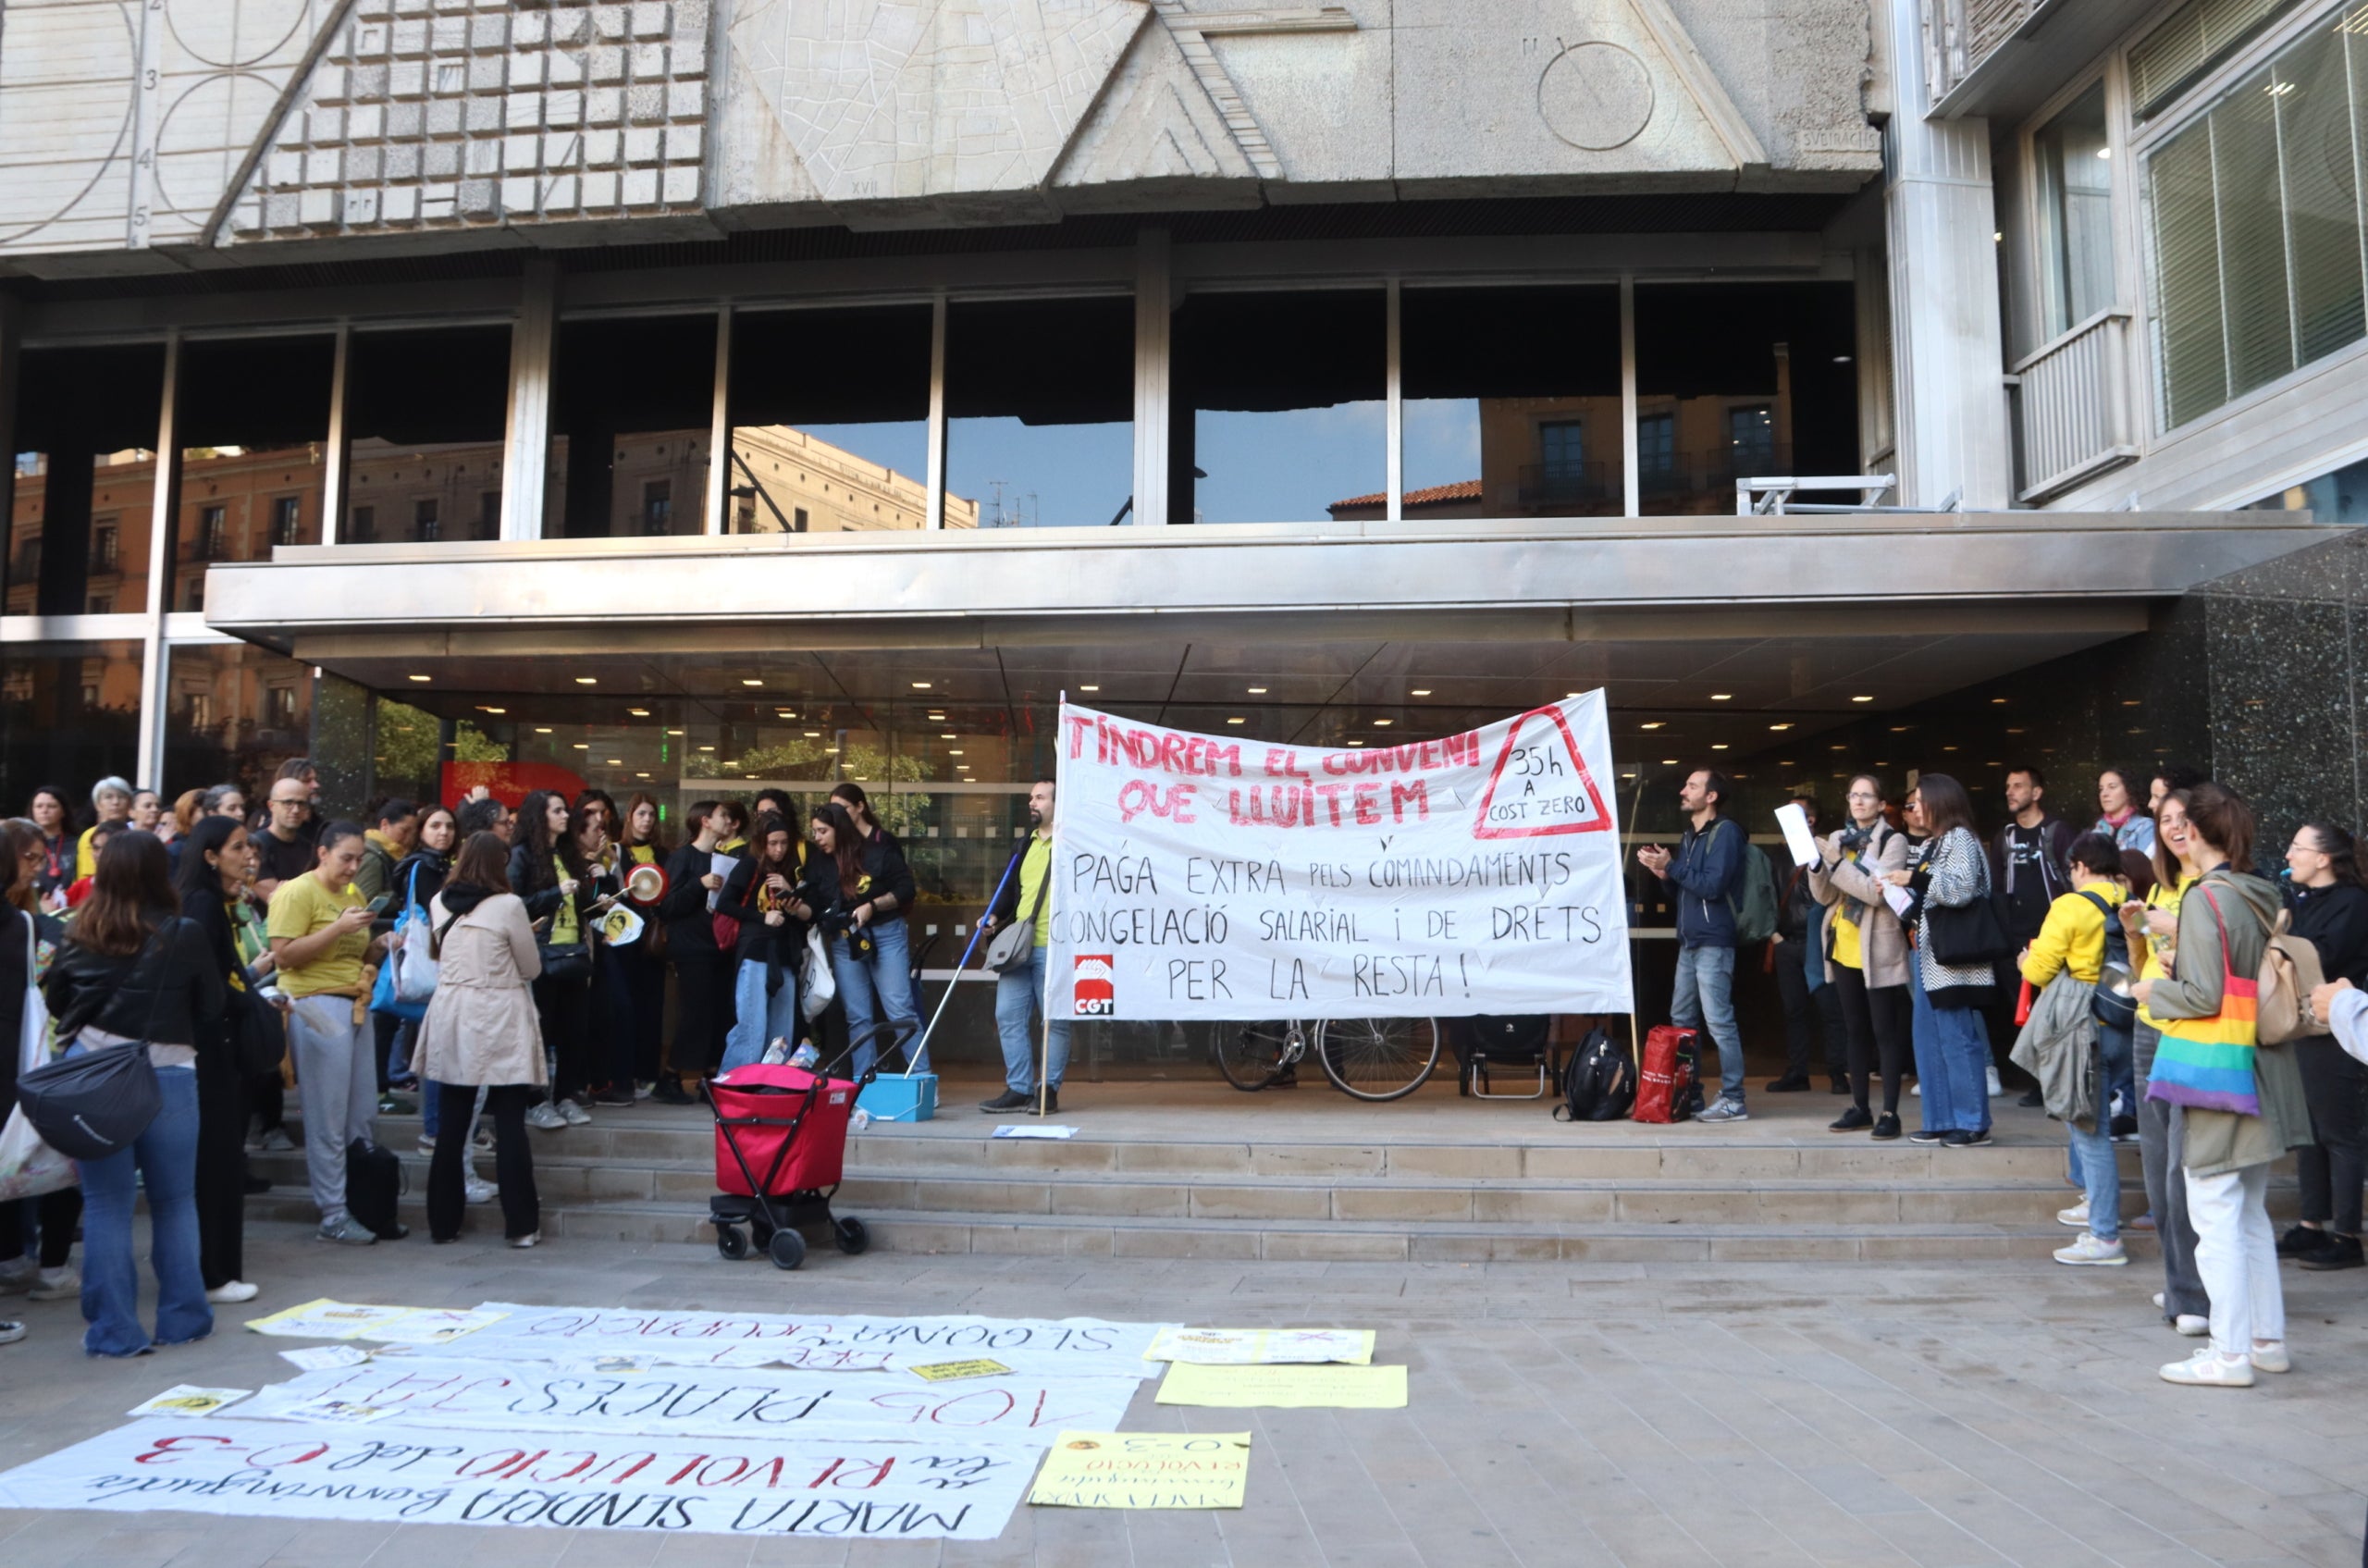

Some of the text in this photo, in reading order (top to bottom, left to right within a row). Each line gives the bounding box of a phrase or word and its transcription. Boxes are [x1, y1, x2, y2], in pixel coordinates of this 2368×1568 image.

[142, 69, 157, 91] 3
[137, 147, 154, 169] 4
[851, 180, 878, 194] XVII
[132, 204, 149, 228] 5
[1264, 747, 1311, 778] EL
[1510, 745, 1563, 777] 35h
[1117, 779, 1198, 823] QUE
[1523, 778, 1536, 797] A
[1489, 795, 1586, 822] COST ZERO
[1073, 851, 1572, 896] PAGA EXTRA PELS COMANDAMENTS
[1427, 909, 1459, 941] DE
[1491, 905, 1602, 945] DRETS
[1167, 957, 1233, 1001] PER
[1269, 957, 1310, 1001] LA
[1074, 998, 1114, 1015] CGT
[507, 1379, 833, 1425] PLACES
[867, 1388, 1094, 1428] 105
[134, 1435, 331, 1469] 0-3
[327, 1440, 465, 1472] del
[461, 1487, 709, 1531] SENDRA
